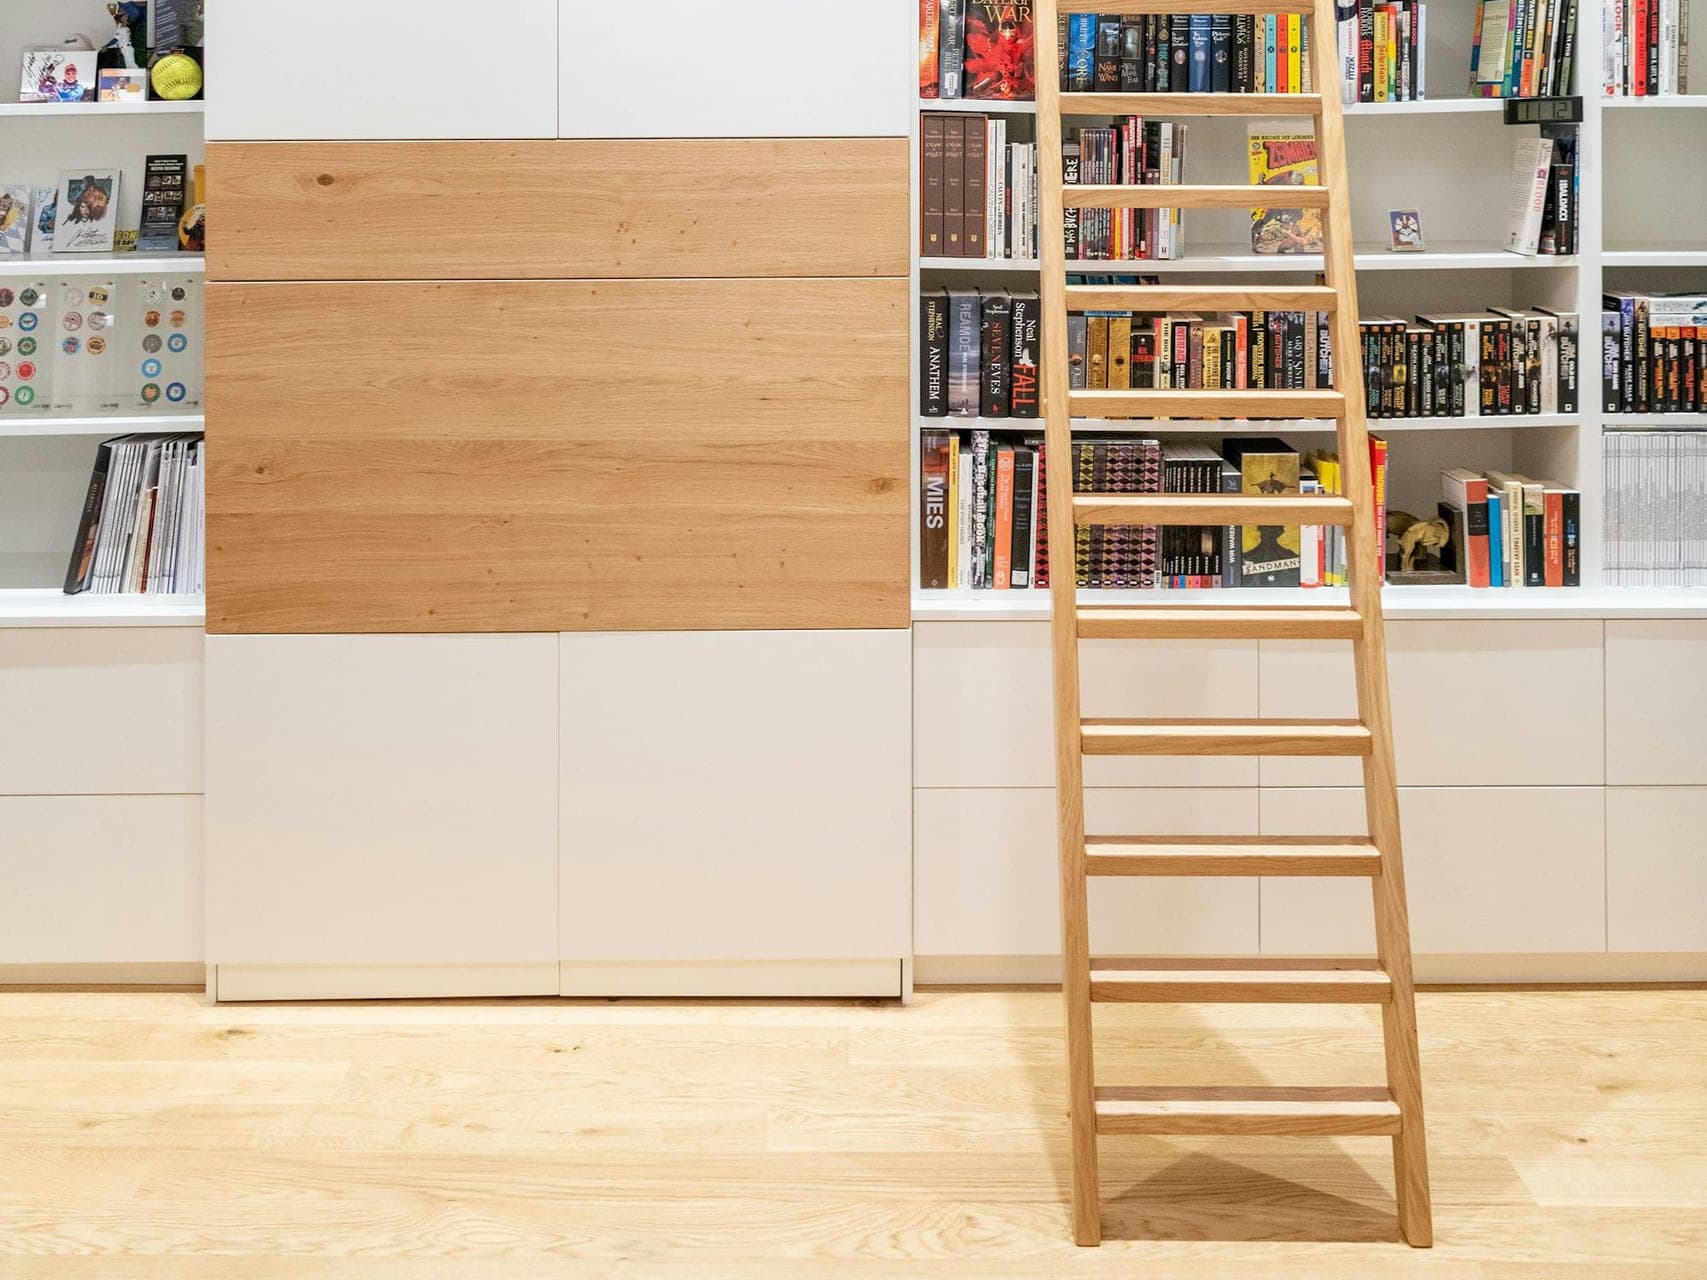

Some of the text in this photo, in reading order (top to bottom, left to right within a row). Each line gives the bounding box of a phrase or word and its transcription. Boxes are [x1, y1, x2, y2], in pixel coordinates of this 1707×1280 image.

[983, 5, 1033, 23] WAR
[1360, 40, 1373, 73] Munich
[1533, 180, 1546, 212] BLOOD
[927, 301, 936, 341] STEPHENSON
[959, 302, 970, 351] REAMDE
[1013, 302, 1026, 357] Stephenson
[1026, 319, 1037, 341] Neal
[990, 322, 1001, 394] SEVENEVES
[1294, 335, 1302, 359] GREY
[1320, 330, 1329, 374] BUTCHER
[1624, 326, 1632, 360] BUTCHER
[928, 346, 940, 400] ANATHEM
[1012, 362, 1038, 409] FALL
[926, 476, 944, 529] MIES
[1246, 556, 1300, 574] SANDMAN
